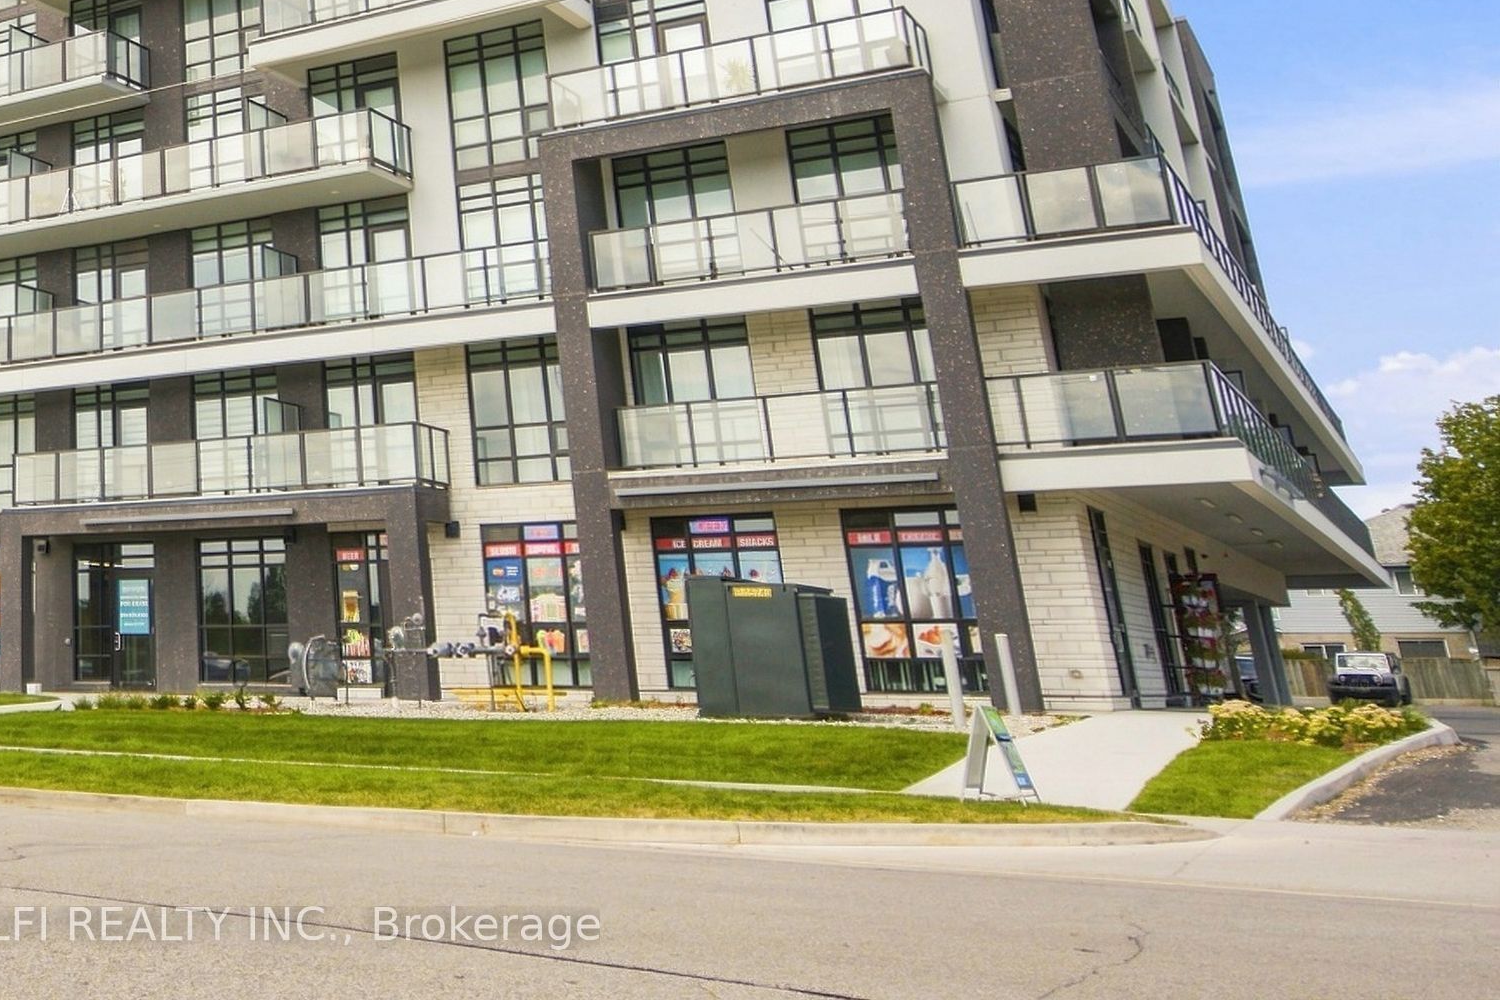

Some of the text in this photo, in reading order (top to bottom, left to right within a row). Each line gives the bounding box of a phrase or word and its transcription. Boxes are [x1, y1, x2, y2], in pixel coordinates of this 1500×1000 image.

[672, 538, 723, 549] ICE CREAM
[739, 535, 774, 547] SNACKS
